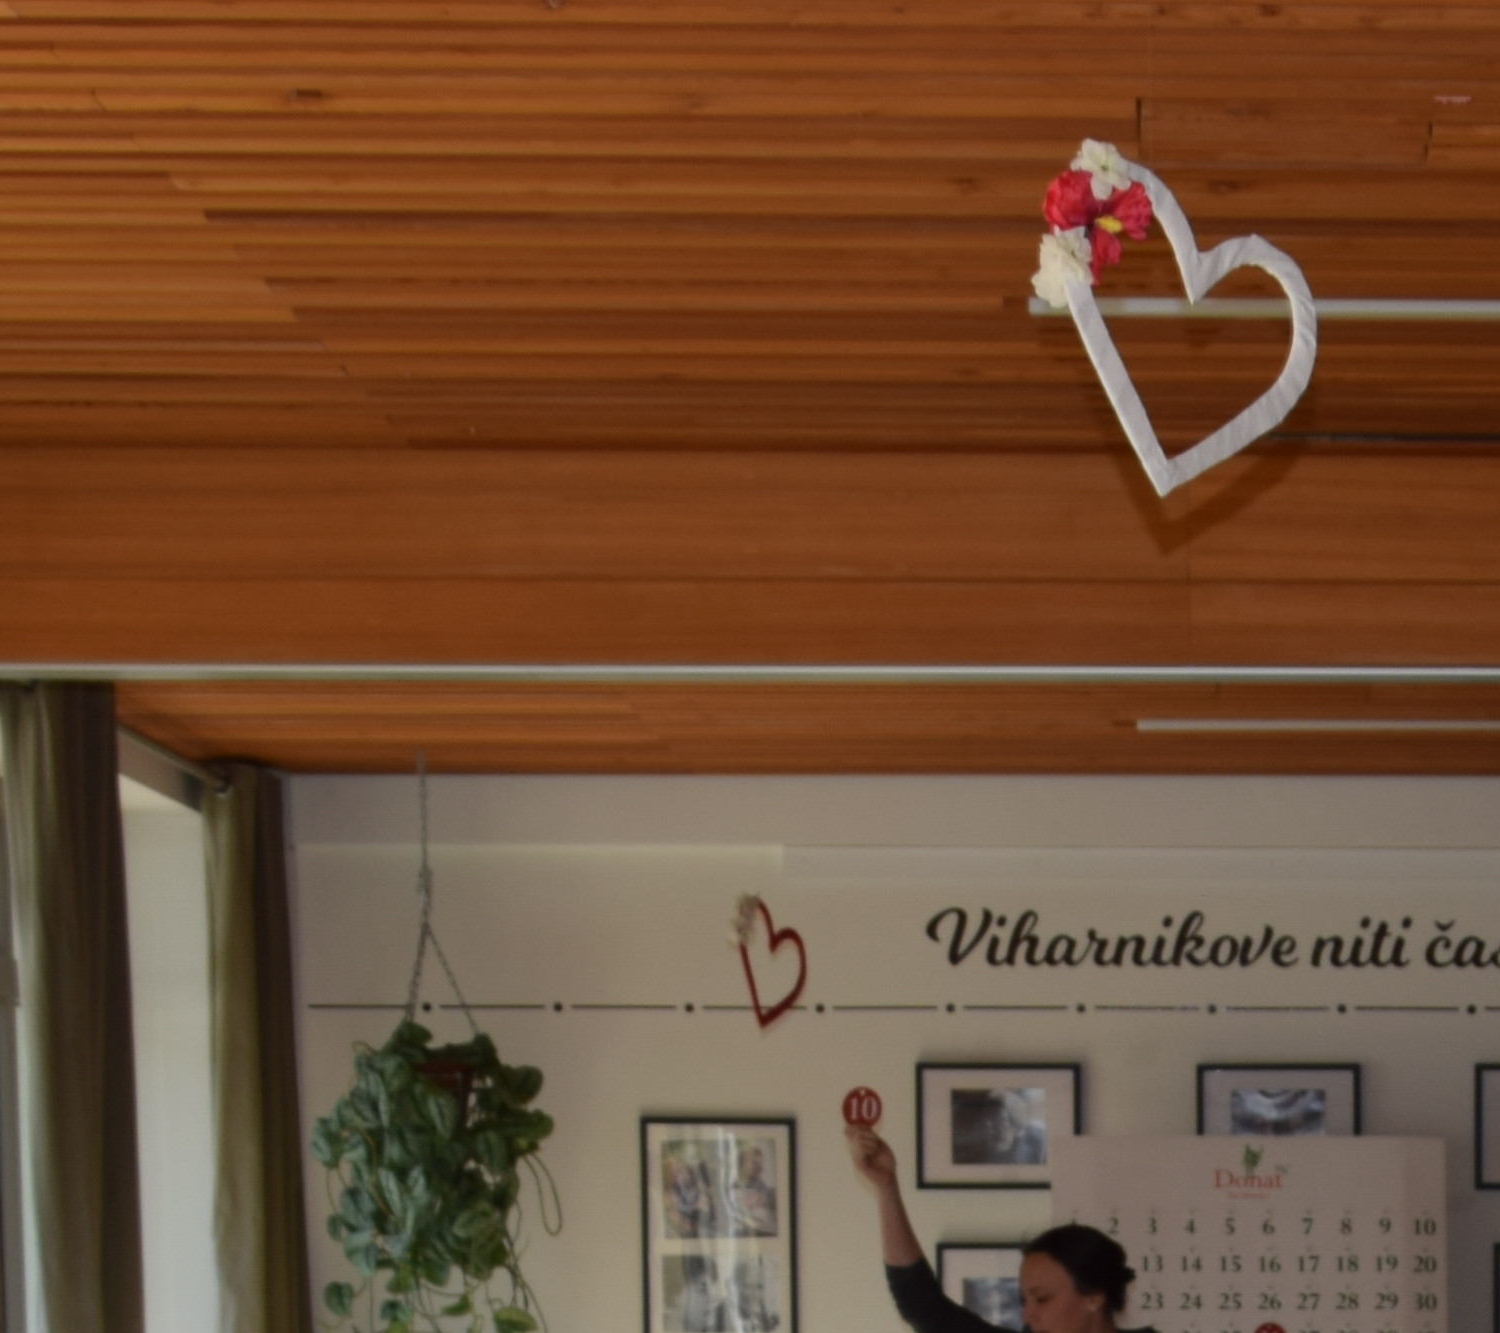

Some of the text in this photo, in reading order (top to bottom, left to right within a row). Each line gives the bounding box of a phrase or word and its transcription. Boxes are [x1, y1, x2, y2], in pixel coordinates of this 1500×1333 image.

[926, 906, 1299, 967] Viharnikove
[1311, 916, 1412, 968] niti
[850, 1097, 877, 1120] 10
[1214, 1168, 1283, 1189] Donat
[1106, 1215, 1436, 1236] 2 3 4 5 6 7 8 9 10
[1141, 1255, 1436, 1273] 13 14 15 16 17 18 19 20
[1141, 1292, 1437, 1310] 23 24 25 26 27 28 29 30
